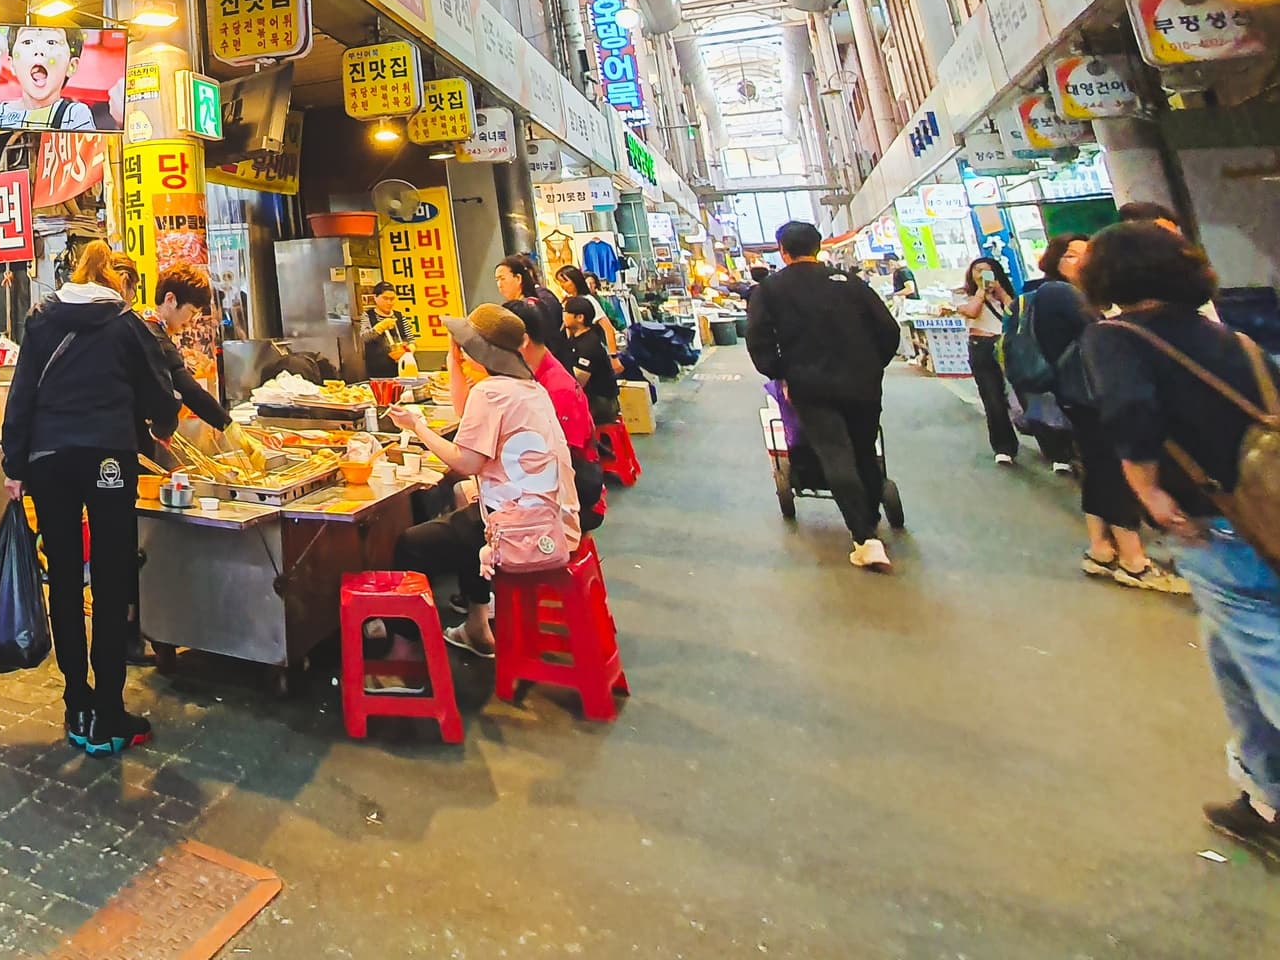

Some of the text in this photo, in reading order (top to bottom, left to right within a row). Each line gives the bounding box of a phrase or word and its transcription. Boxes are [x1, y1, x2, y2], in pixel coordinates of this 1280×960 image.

[349, 55, 408, 84] 진맛집
[421, 90, 464, 113] 맛집
[124, 154, 145, 256] 떡볶이
